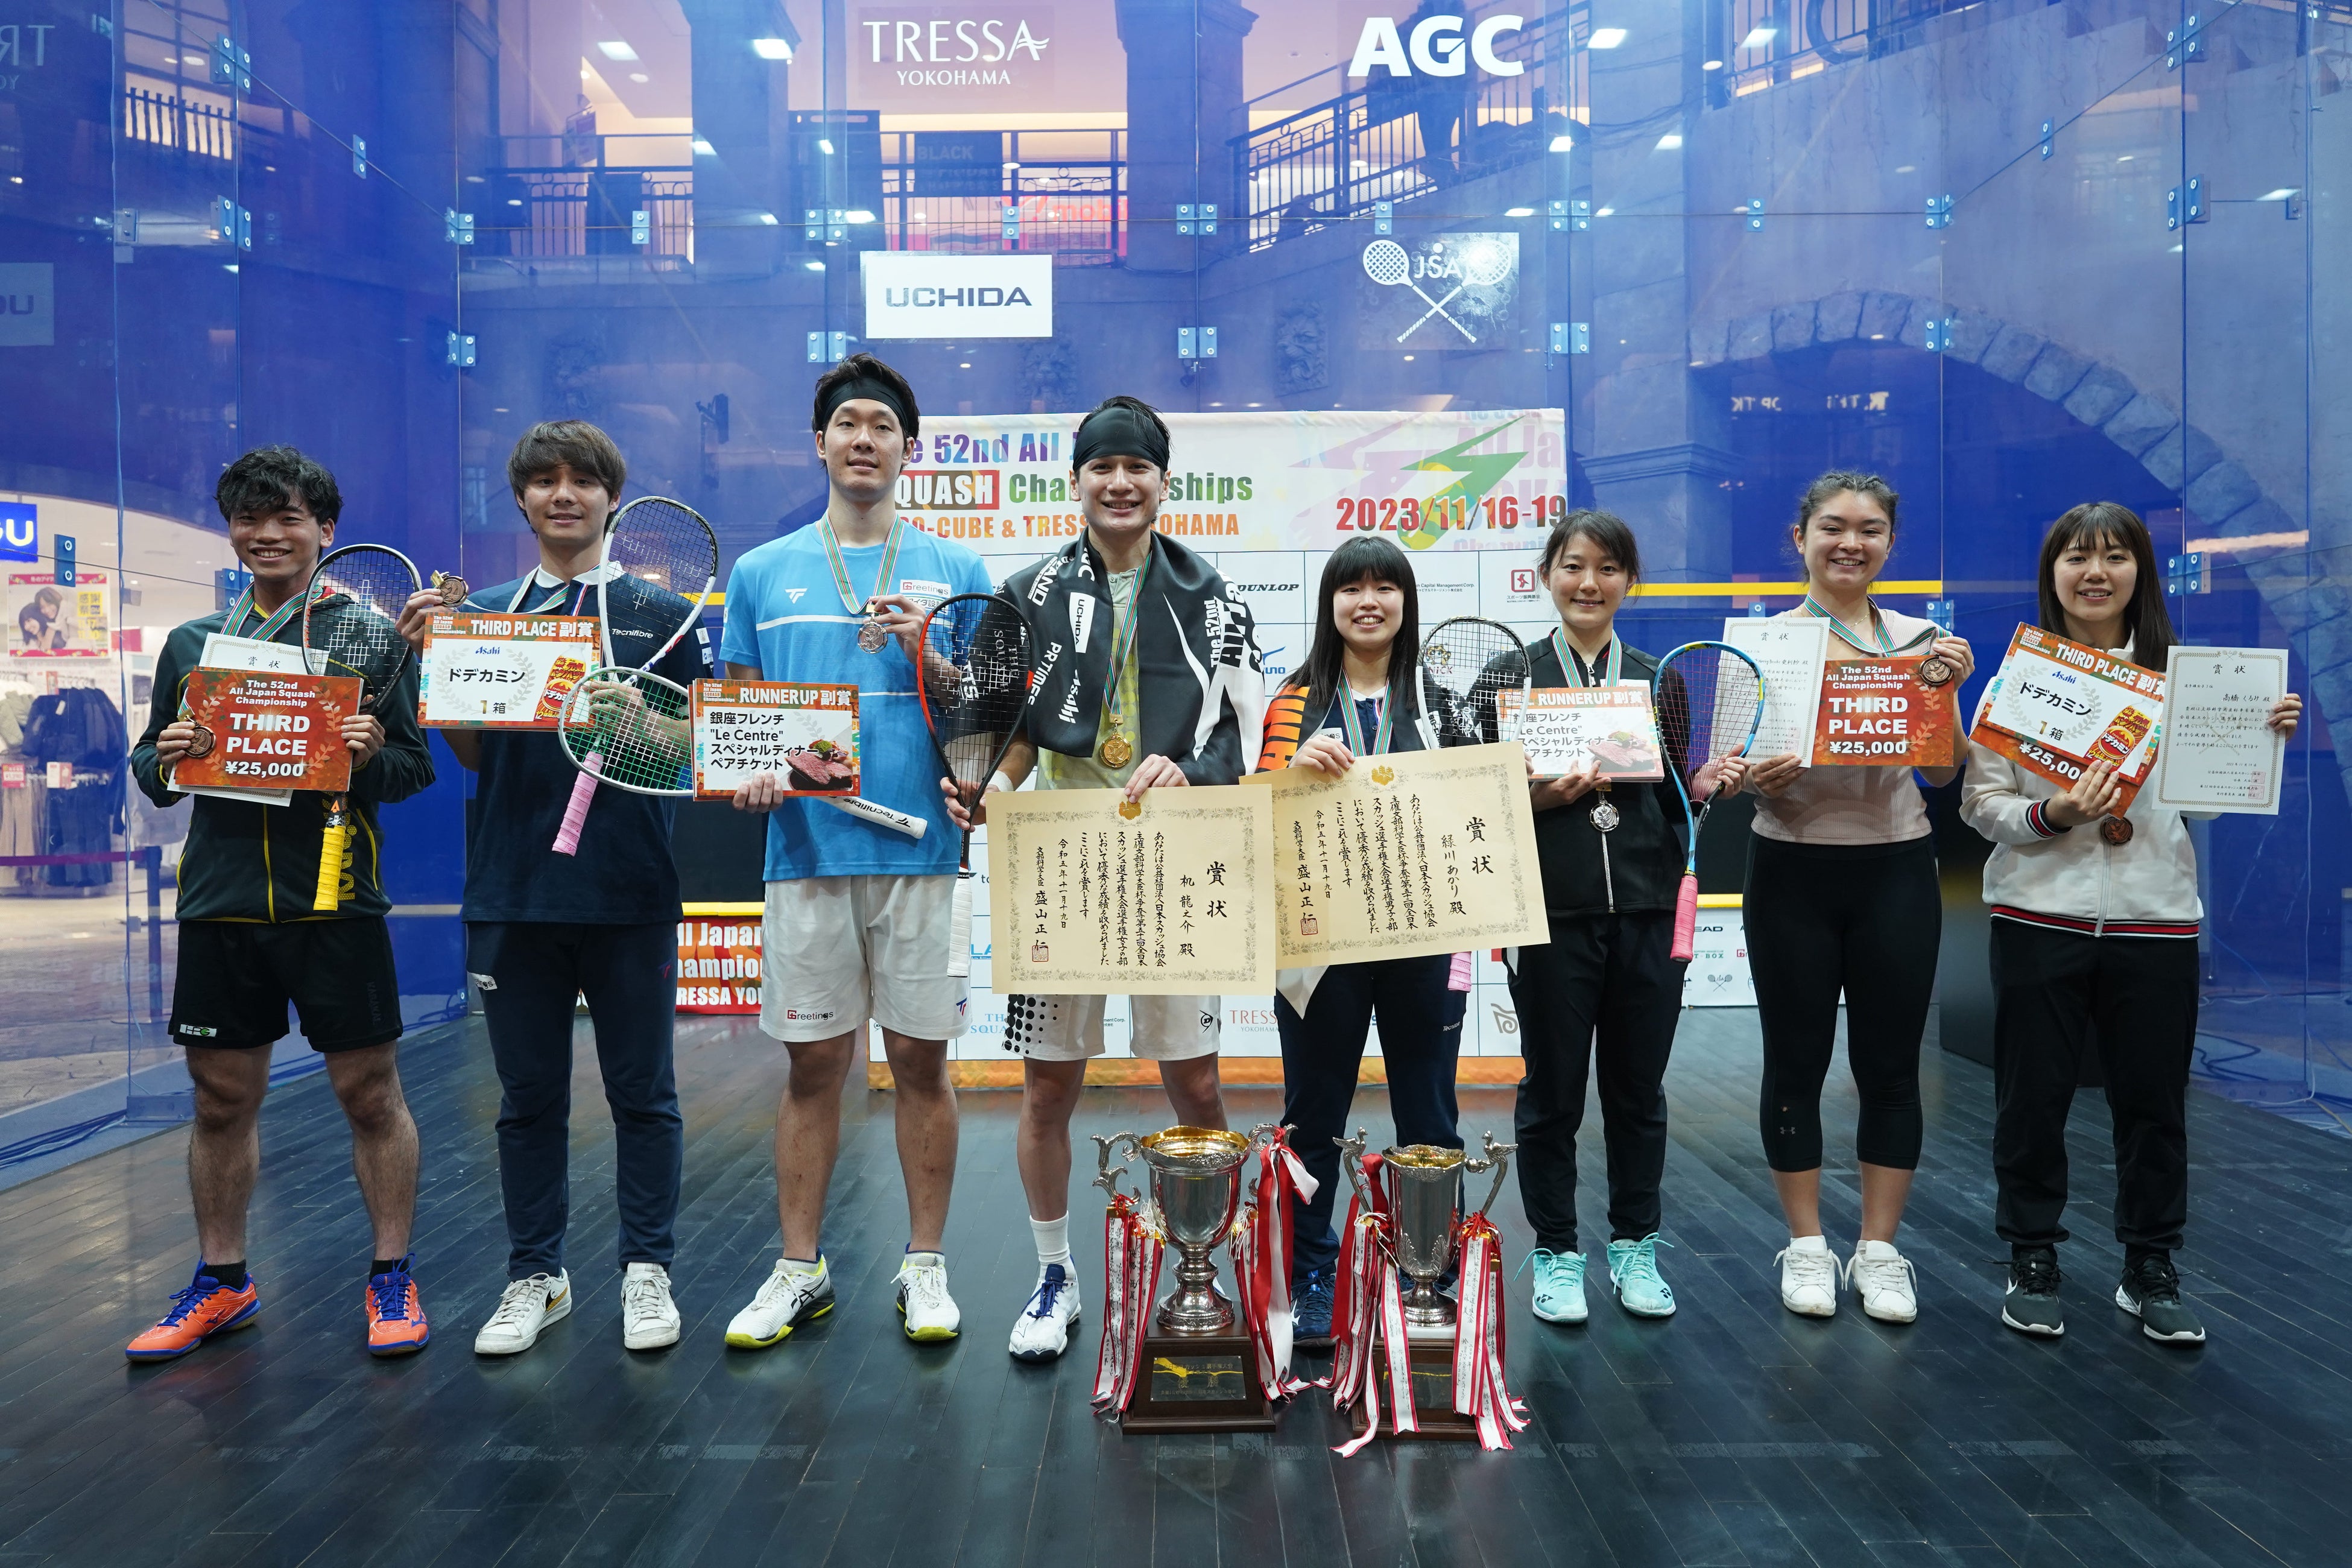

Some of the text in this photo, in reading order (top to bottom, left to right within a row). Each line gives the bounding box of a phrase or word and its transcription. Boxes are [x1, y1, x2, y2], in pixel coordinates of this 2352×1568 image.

[862, 19, 1050, 62] TRESSA
[1347, 14, 1525, 77] AGC
[896, 70, 1011, 85] YOKOHAMA
[917, 145, 974, 160] BLACK
[1414, 255, 1463, 279] JSA
[886, 286, 1032, 308] UCHIDA
[934, 433, 1009, 463] 52nd
[1019, 432, 1059, 461] All
[1336, 496, 1566, 532] 2023/11/16-19
[1002, 518, 1016, 536] &
[903, 582, 949, 595] Greetings
[471, 620, 594, 637] THIRD PLACE 副賞
[1075, 599, 1085, 645] UCHIDA
[612, 628, 654, 639] Tecnifibre
[1204, 599, 1221, 668] The 52nd
[1761, 632, 1789, 641] 賞状
[475, 646, 501, 656] Asahi
[248, 656, 280, 669] 賞状
[2056, 643, 2096, 669] THIRD
[2094, 656, 2138, 686] PLACE
[2213, 664, 2246, 675] 賞状
[449, 668, 526, 684] ドデカミン
[1842, 673, 1871, 682] Japan
[1874, 673, 1910, 682] Squash
[2052, 670, 2077, 684] Asahi
[229, 686, 315, 699] All Japan Squash
[246, 680, 298, 690] The 52nd
[1832, 681, 1903, 690] Championship
[235, 697, 308, 708] Championship
[820, 690, 852, 706] 副賞
[1613, 691, 1644, 704] 副賞
[1829, 697, 1908, 713] THIRD
[2020, 681, 2092, 715] ドデカミン
[480, 700, 506, 715] 1 箱
[229, 713, 311, 732] THIRD
[710, 712, 784, 725] 銀座フレンチ
[1829, 719, 1908, 734] PLACE
[734, 729, 783, 741] Centre"
[1537, 726, 1582, 735] Centre"
[2038, 721, 2064, 741] 1 箱
[226, 737, 307, 756] PLACE
[711, 743, 818, 757] スペシャルディナー
[1830, 742, 1907, 756] ¥25,000
[225, 761, 304, 778] ¥25,000
[710, 758, 783, 770] ペアチケット
[1336, 801, 1353, 888] ここにこれを賞します
[1466, 817, 1494, 874] 賞状
[1058, 839, 1069, 928] 令和五年十一月十九日
[1079, 832, 1091, 920] ここにこれを賞します
[1207, 861, 1227, 918] 賞状
[1097, 832, 1110, 966] において優秀な成績を収められました
[1116, 831, 1128, 967] スカッシュ選手権大会選手権女子の部
[1154, 831, 1167, 967] あなたは公益社団法人日本スカッシュ協会
[787, 1010, 834, 1020] Greetings
